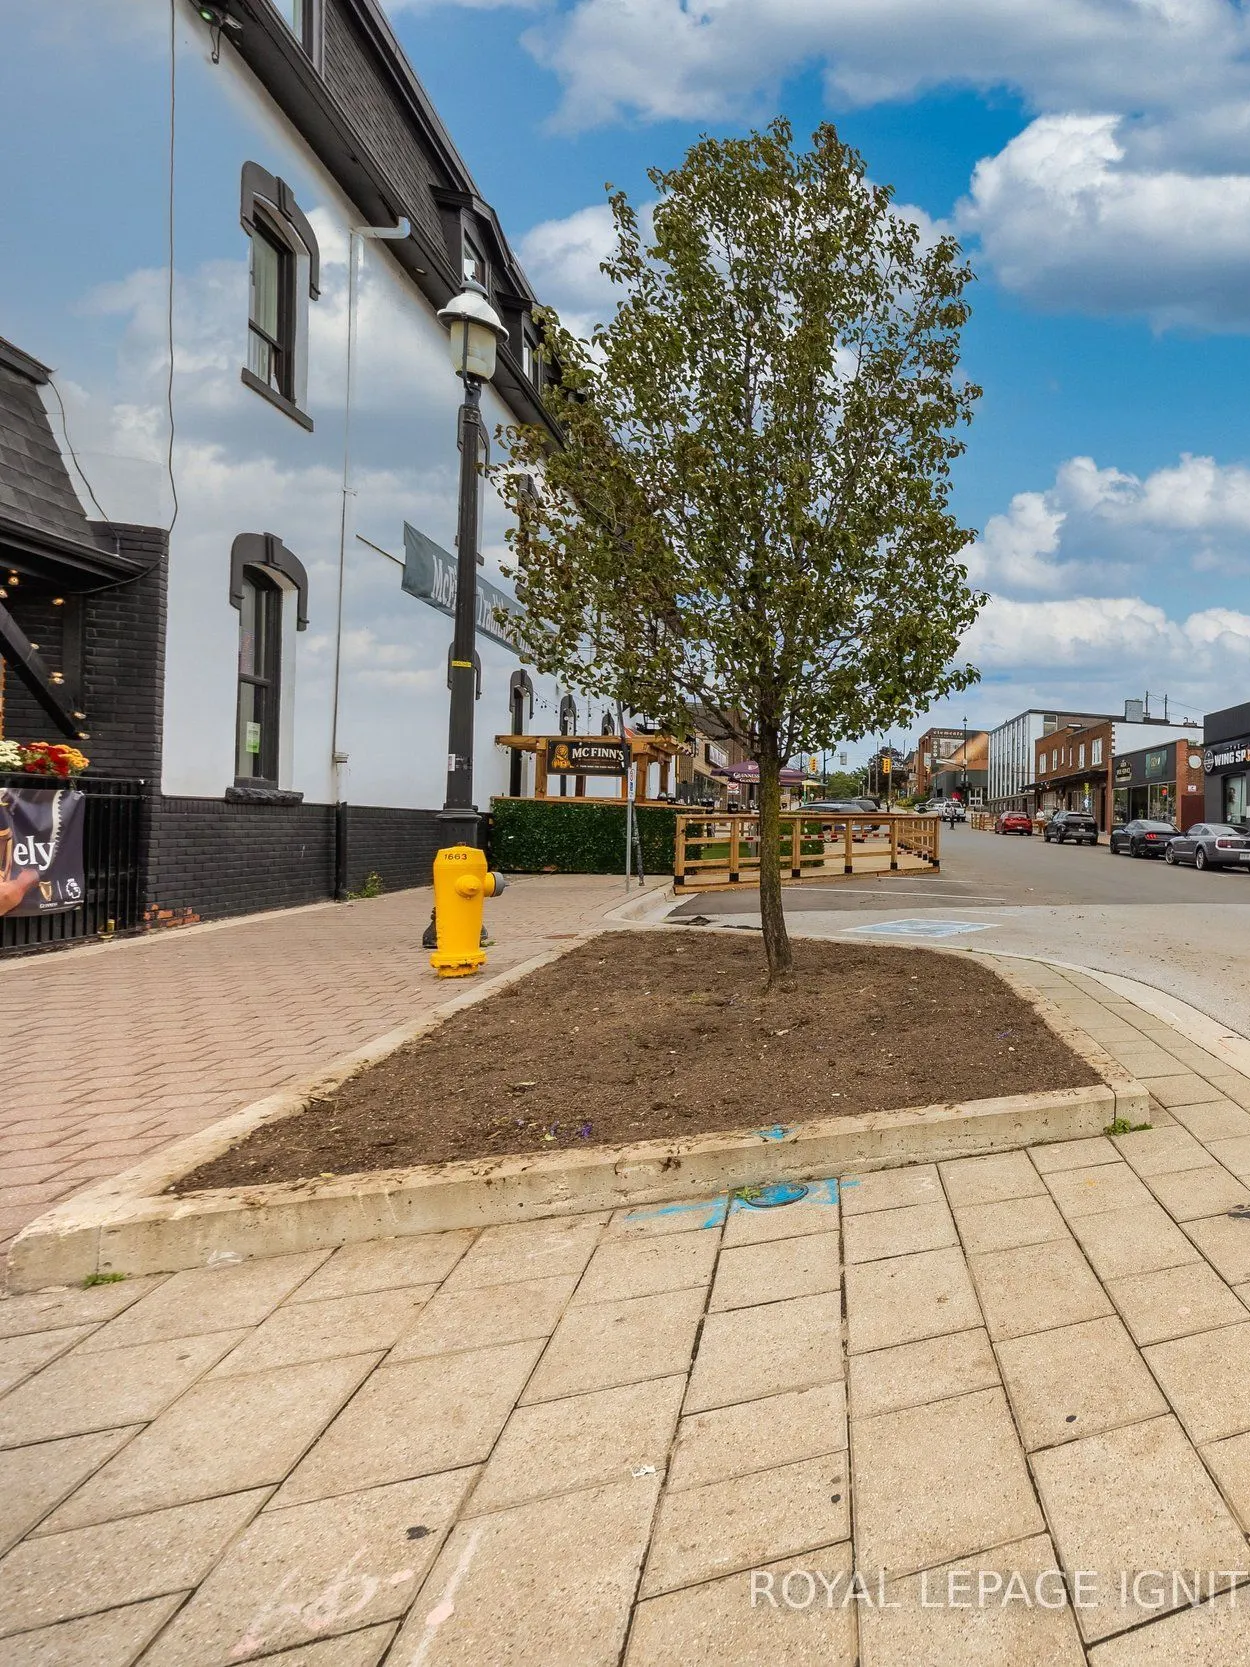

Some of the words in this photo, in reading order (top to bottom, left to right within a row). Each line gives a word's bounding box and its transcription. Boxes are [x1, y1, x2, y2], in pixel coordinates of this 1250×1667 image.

[1214, 751, 1235, 766] WING
[13, 835, 56, 871] ely
[444, 853, 468, 861] 1663
